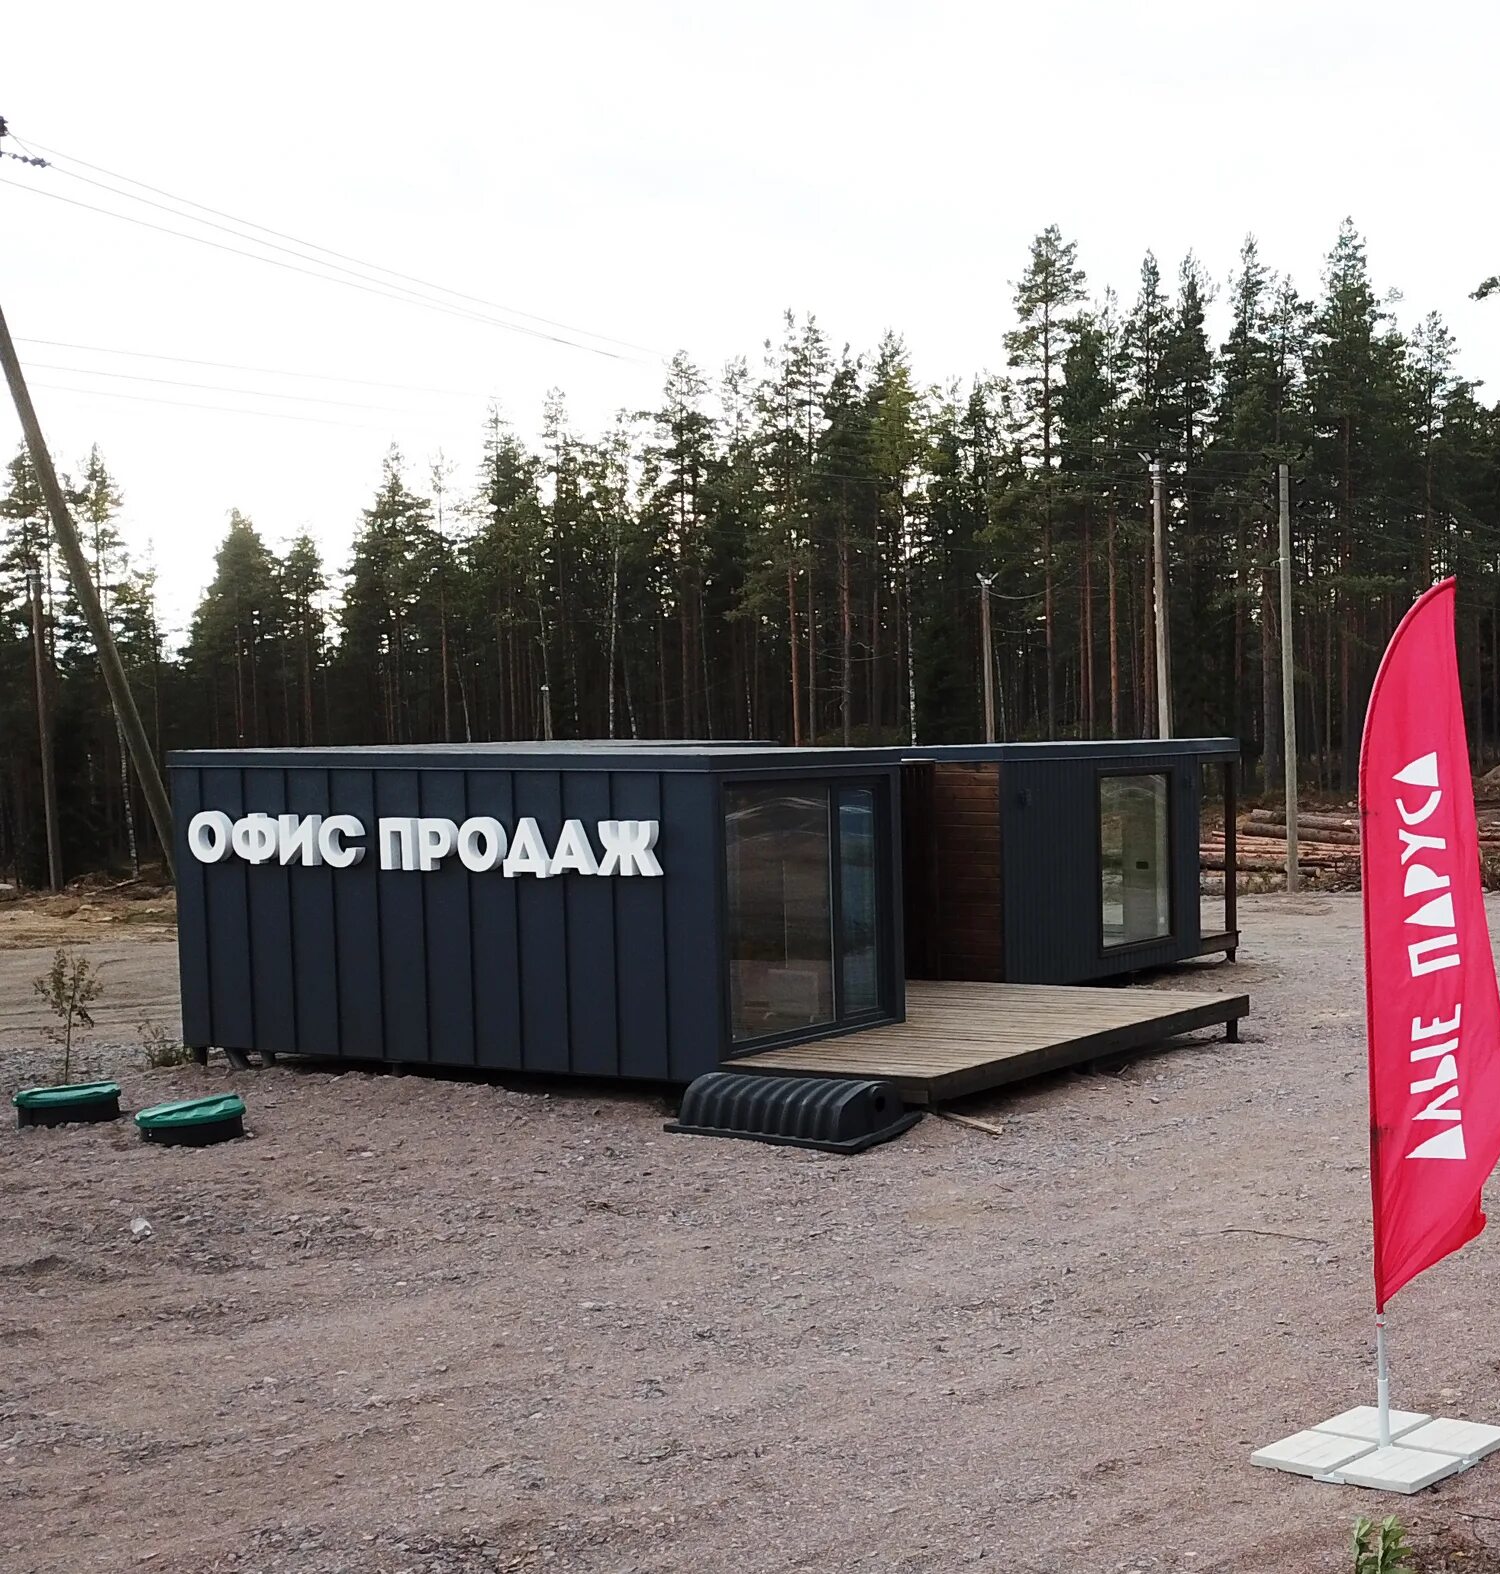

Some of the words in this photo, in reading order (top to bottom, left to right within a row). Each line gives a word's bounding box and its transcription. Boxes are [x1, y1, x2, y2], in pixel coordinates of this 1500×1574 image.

[187, 810, 366, 868] ОФИС
[378, 816, 664, 879] ПРОДАЖ
[1392, 751, 1461, 978] ПАРУСА
[1405, 1003, 1467, 1160] АЛЫЕ
